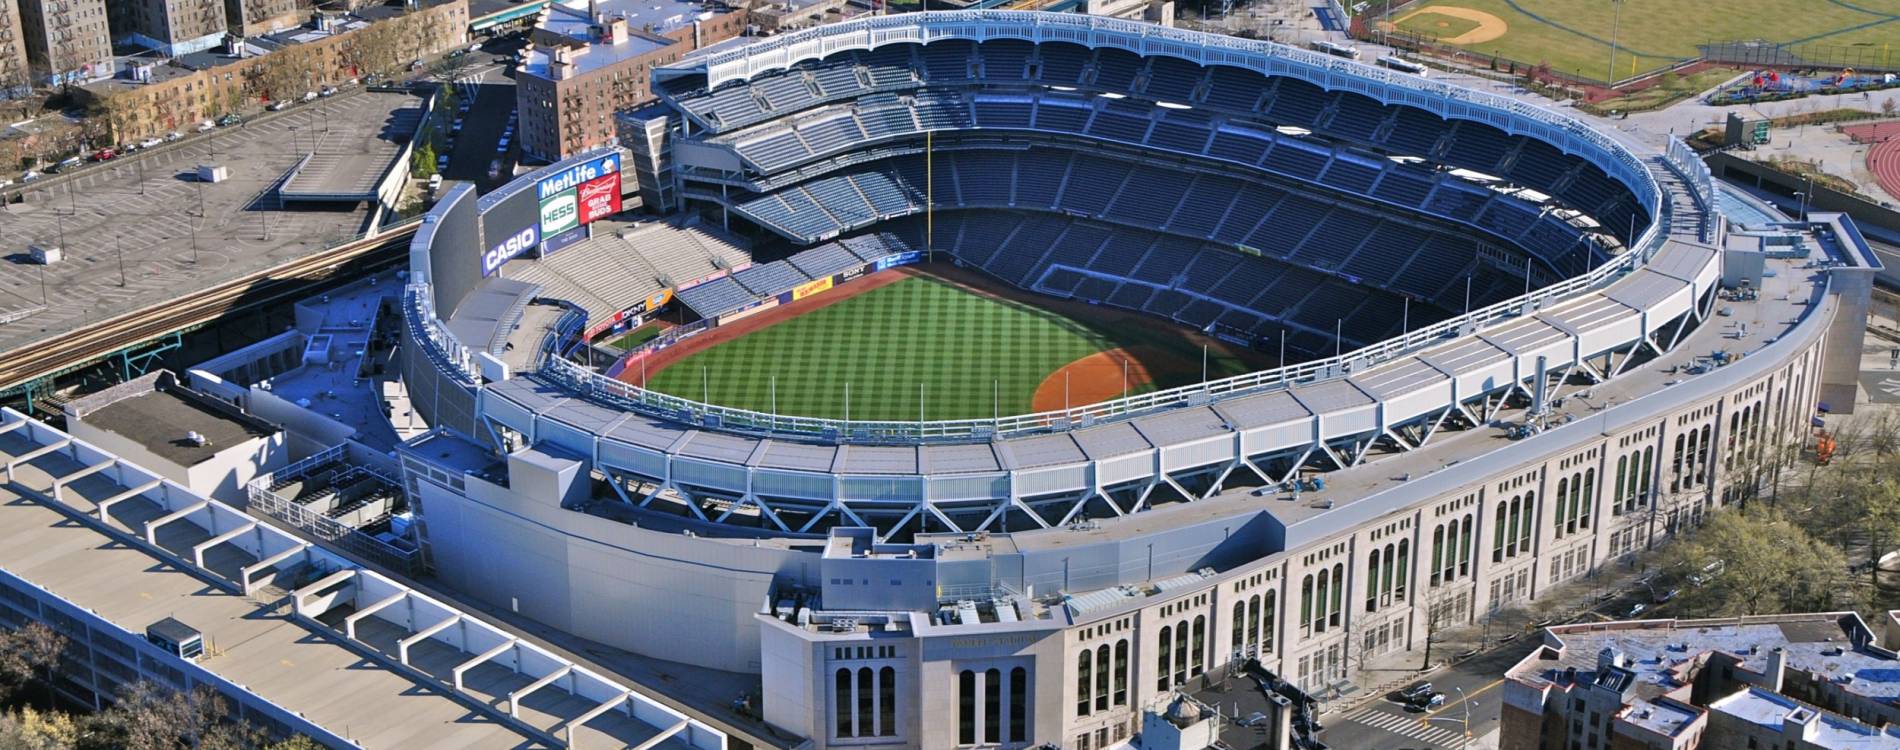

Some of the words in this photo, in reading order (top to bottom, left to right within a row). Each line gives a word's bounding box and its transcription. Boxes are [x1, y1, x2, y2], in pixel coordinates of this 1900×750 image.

[542, 165, 596, 198] MetLife
[588, 194, 612, 207] GRAB
[543, 202, 574, 225] HESS
[588, 205, 612, 219] BUDS
[486, 227, 535, 271] CASIO
[843, 264, 865, 278] SONY
[622, 302, 646, 319] DKNY
